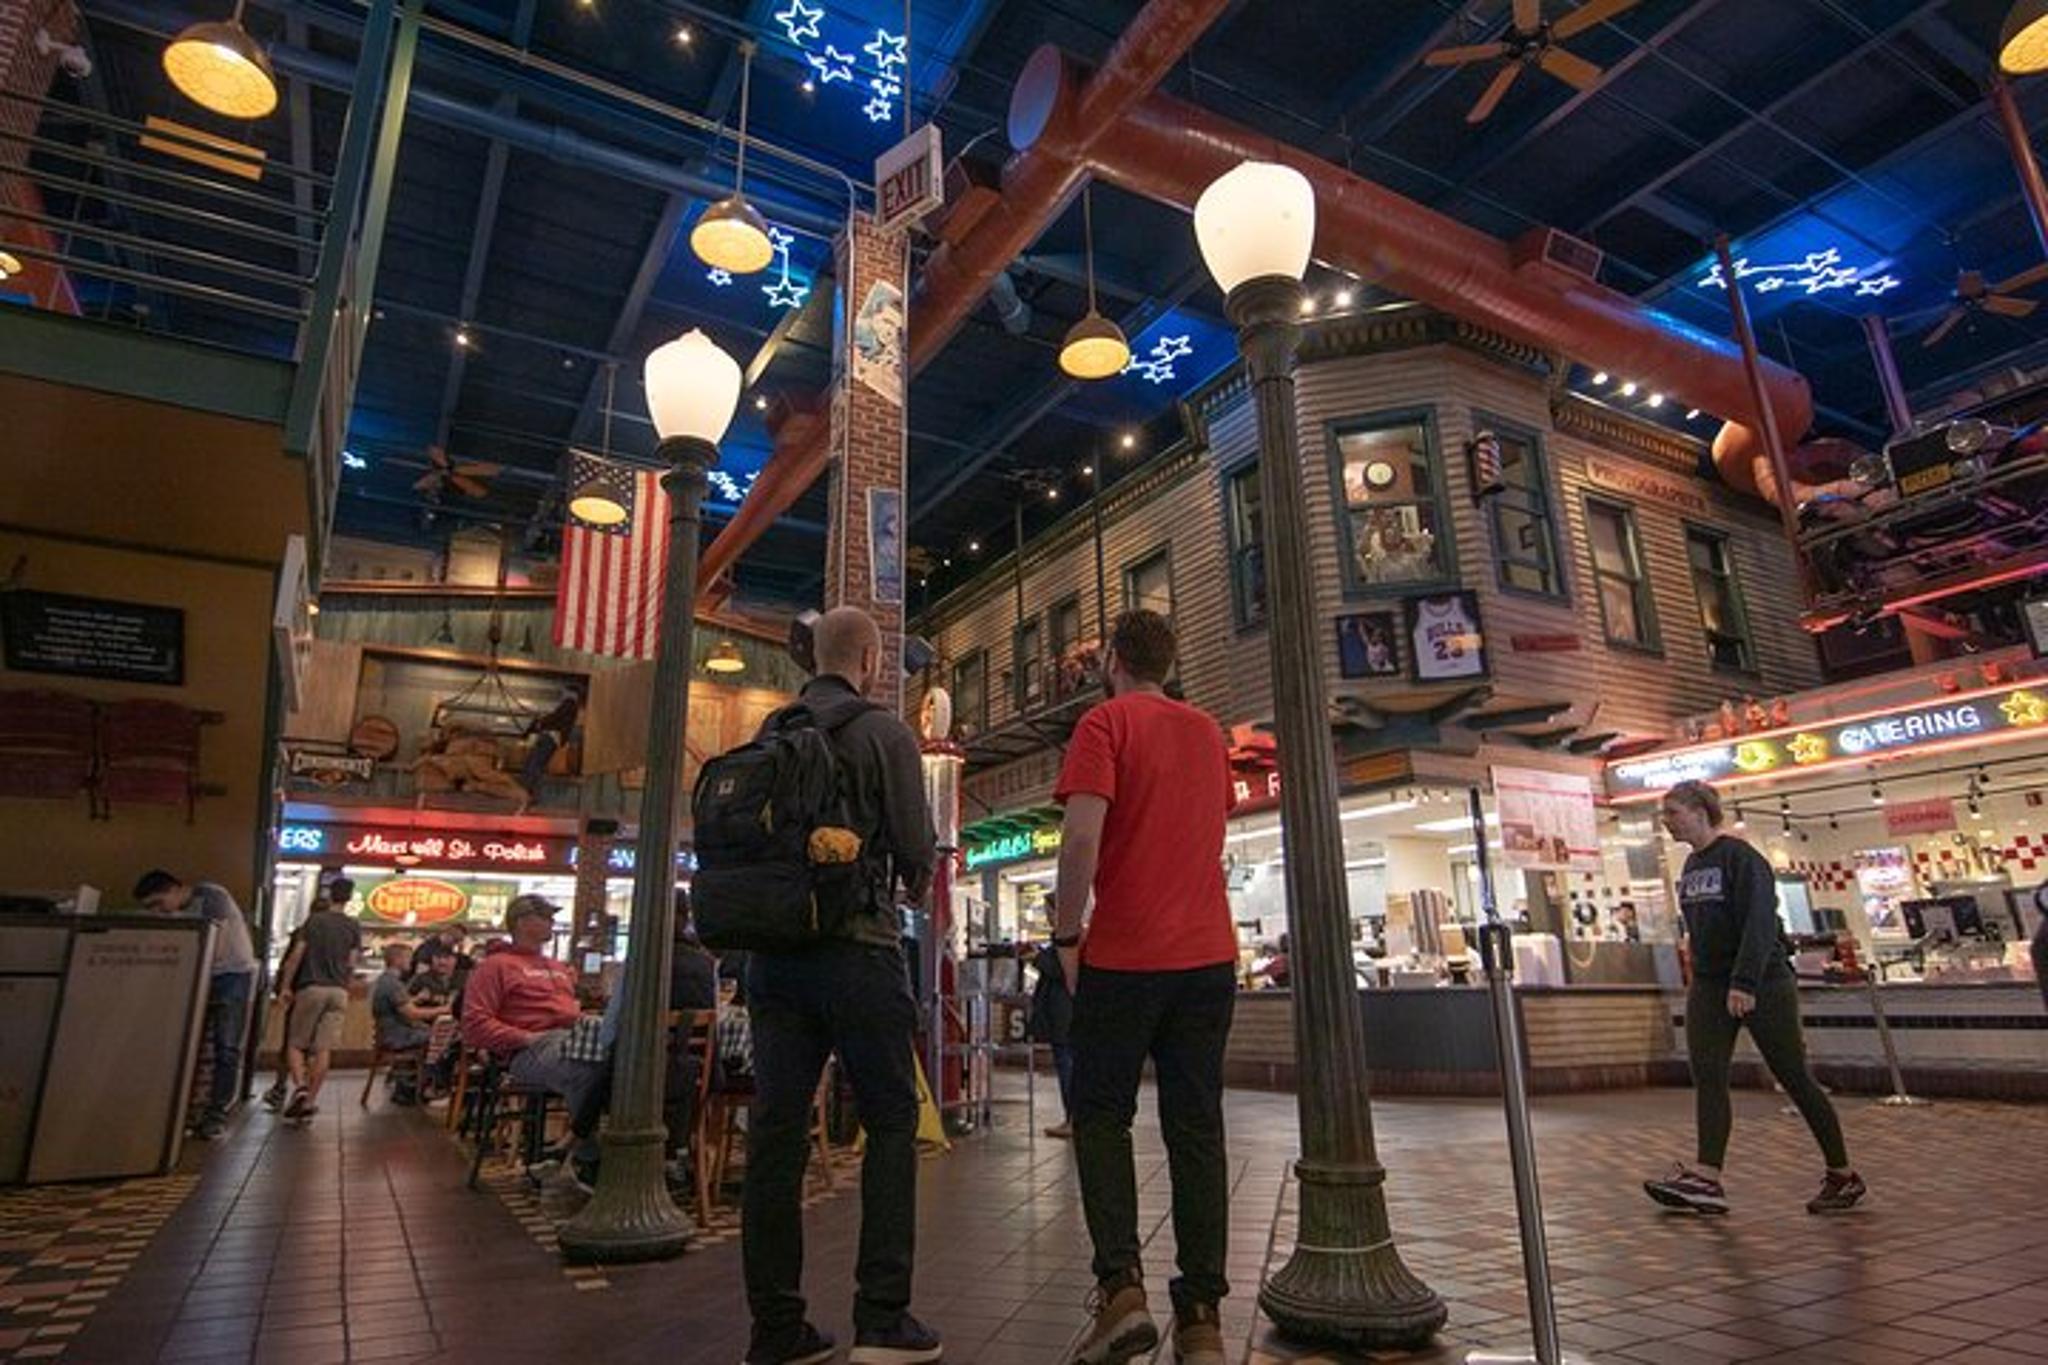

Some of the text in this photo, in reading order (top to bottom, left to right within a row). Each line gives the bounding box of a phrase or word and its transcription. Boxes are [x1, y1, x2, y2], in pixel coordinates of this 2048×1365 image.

[880, 156, 925, 214] EXIT
[1839, 705, 1980, 753] CATERING
[449, 839, 476, 859] St.
